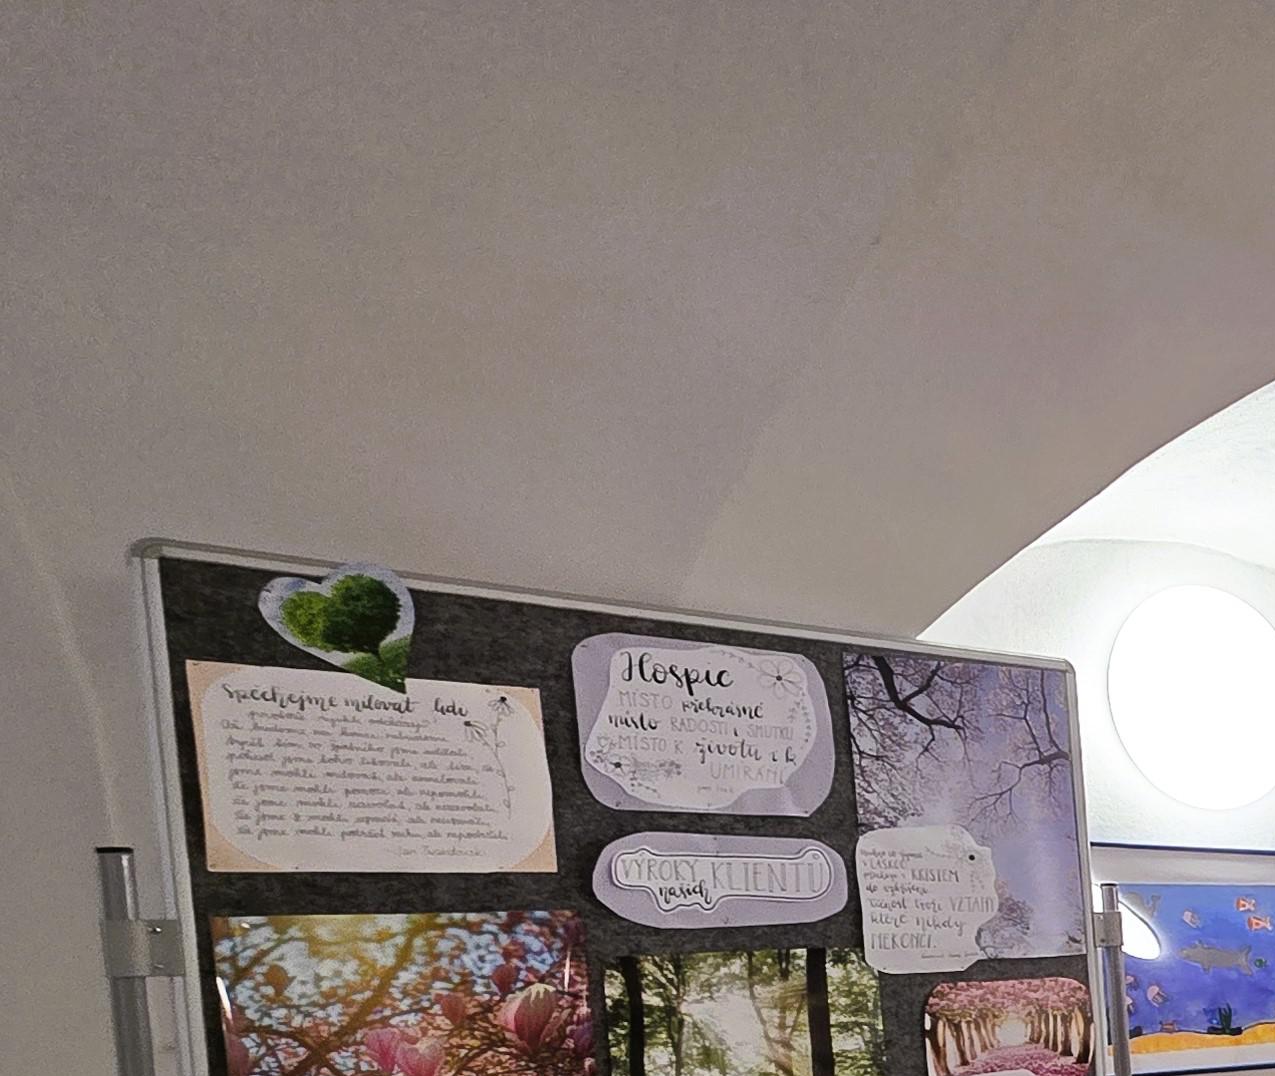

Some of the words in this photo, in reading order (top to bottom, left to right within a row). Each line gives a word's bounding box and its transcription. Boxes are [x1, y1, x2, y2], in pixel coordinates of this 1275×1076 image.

[620, 651, 734, 696] Hospic
[222, 682, 338, 712] Spěchejme
[343, 693, 419, 714] milovat
[669, 716, 729, 737] RADOSTI
[619, 852, 700, 883] VÝROKY
[709, 852, 824, 894] KLIENTŮ
[658, 879, 713, 905] našich
